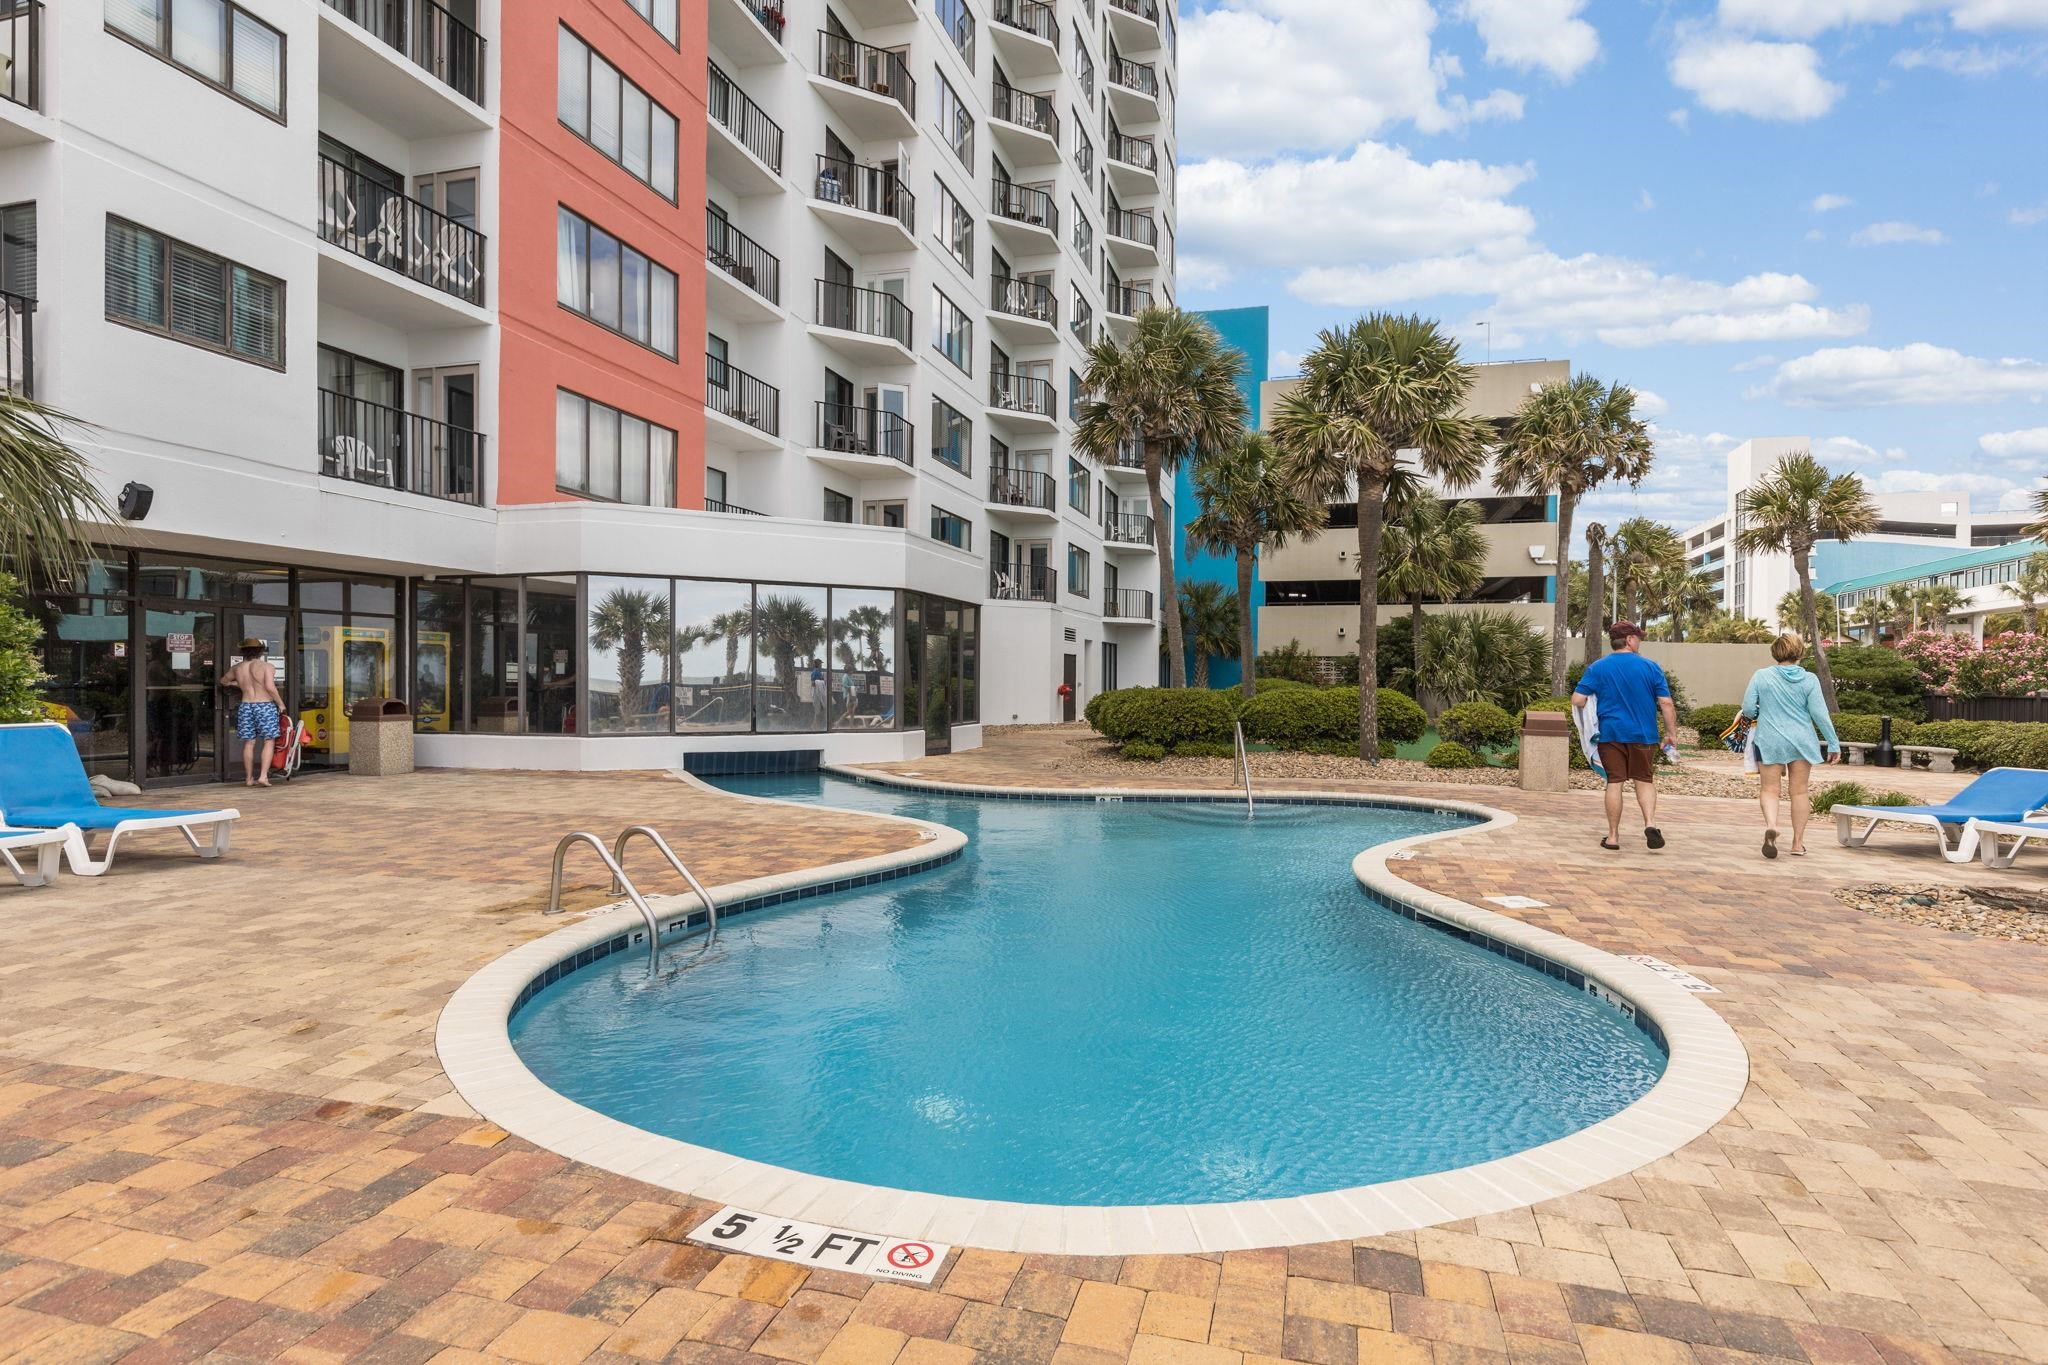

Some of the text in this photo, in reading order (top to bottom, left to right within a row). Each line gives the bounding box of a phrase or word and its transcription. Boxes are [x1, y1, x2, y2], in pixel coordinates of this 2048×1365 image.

[712, 1213, 758, 1239] 5
[810, 1233, 881, 1266] FT
[891, 1270, 923, 1279] DIVING
